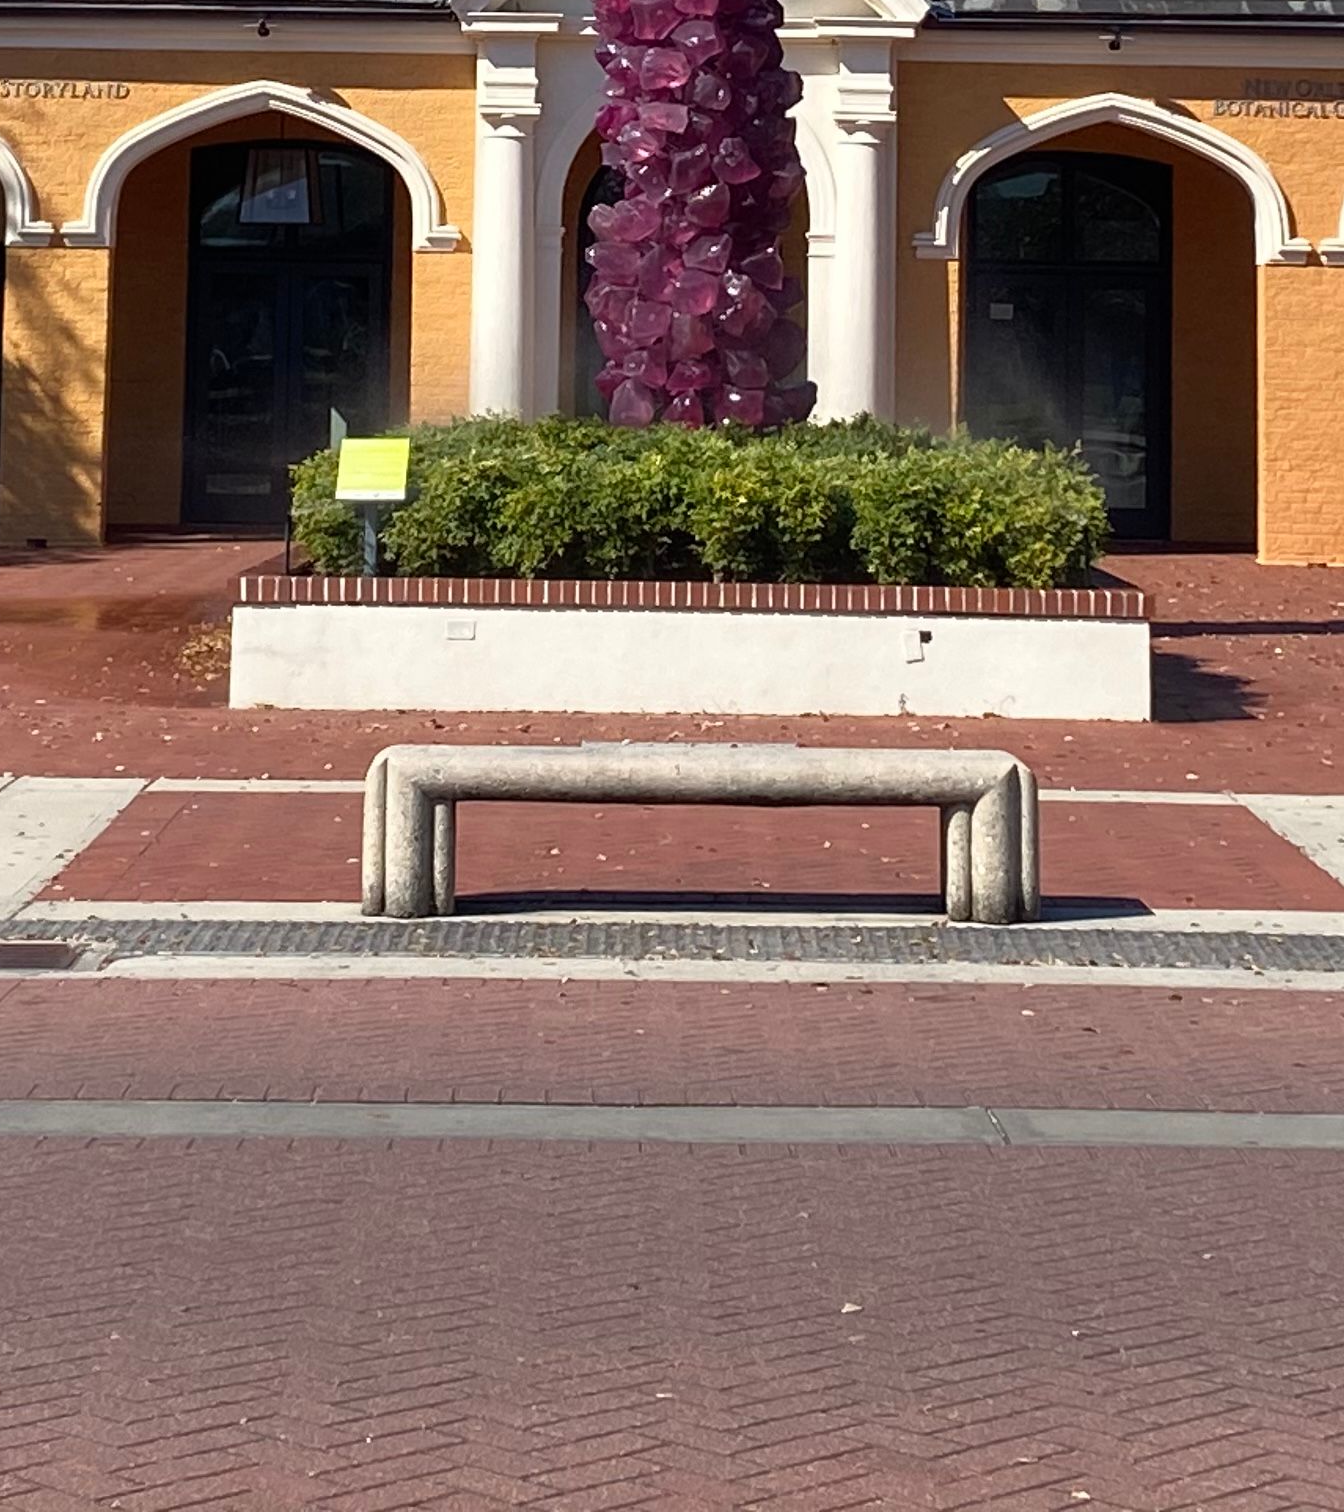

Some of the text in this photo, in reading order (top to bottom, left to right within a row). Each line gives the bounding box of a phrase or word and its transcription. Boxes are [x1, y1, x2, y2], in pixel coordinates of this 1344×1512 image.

[0, 79, 131, 100] STORYLAND
[1243, 78, 1292, 98] NEW
[1213, 99, 1330, 119] BOTANICAL
